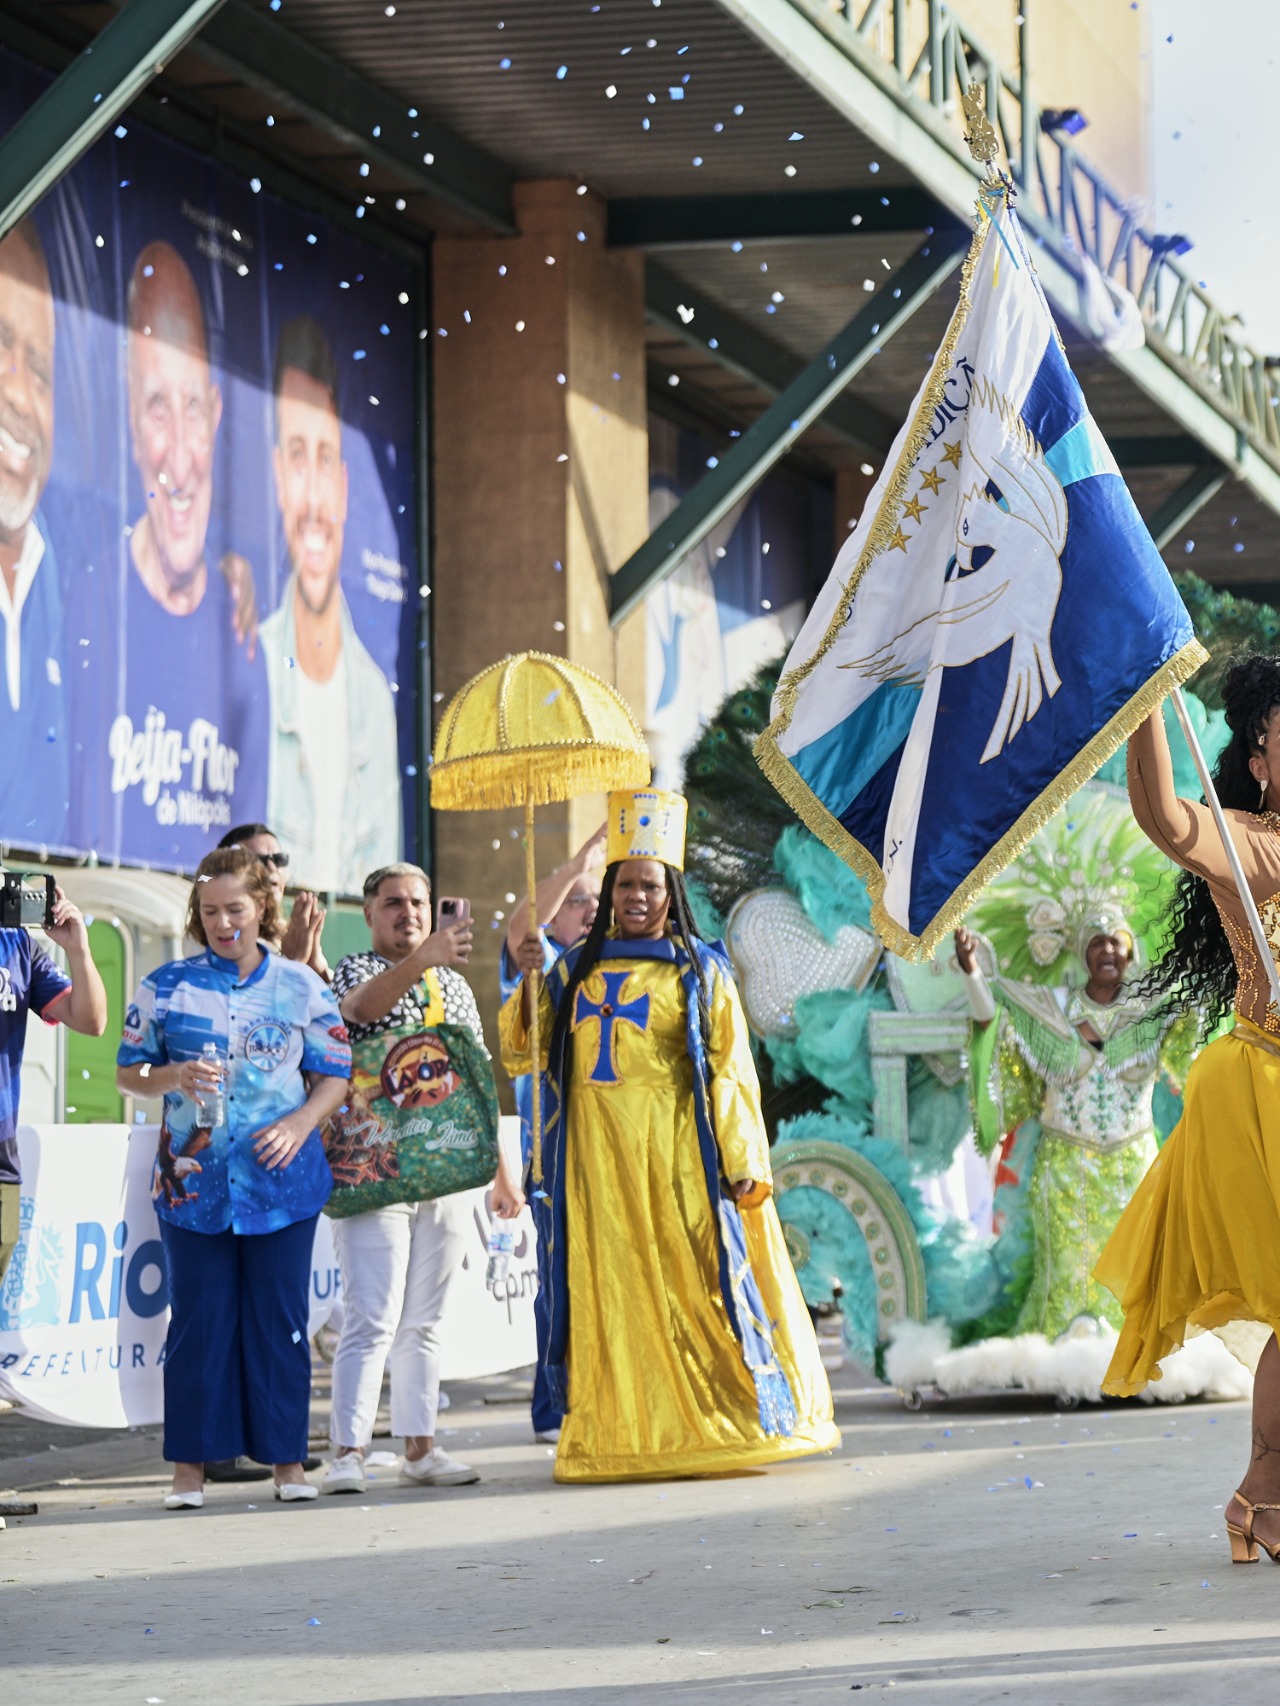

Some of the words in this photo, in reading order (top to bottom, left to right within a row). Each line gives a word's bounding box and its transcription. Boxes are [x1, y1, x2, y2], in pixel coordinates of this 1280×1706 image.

[108, 704, 240, 806] Beija-Flor
[156, 788, 178, 825] de
[68, 1220, 172, 1324] Rio
